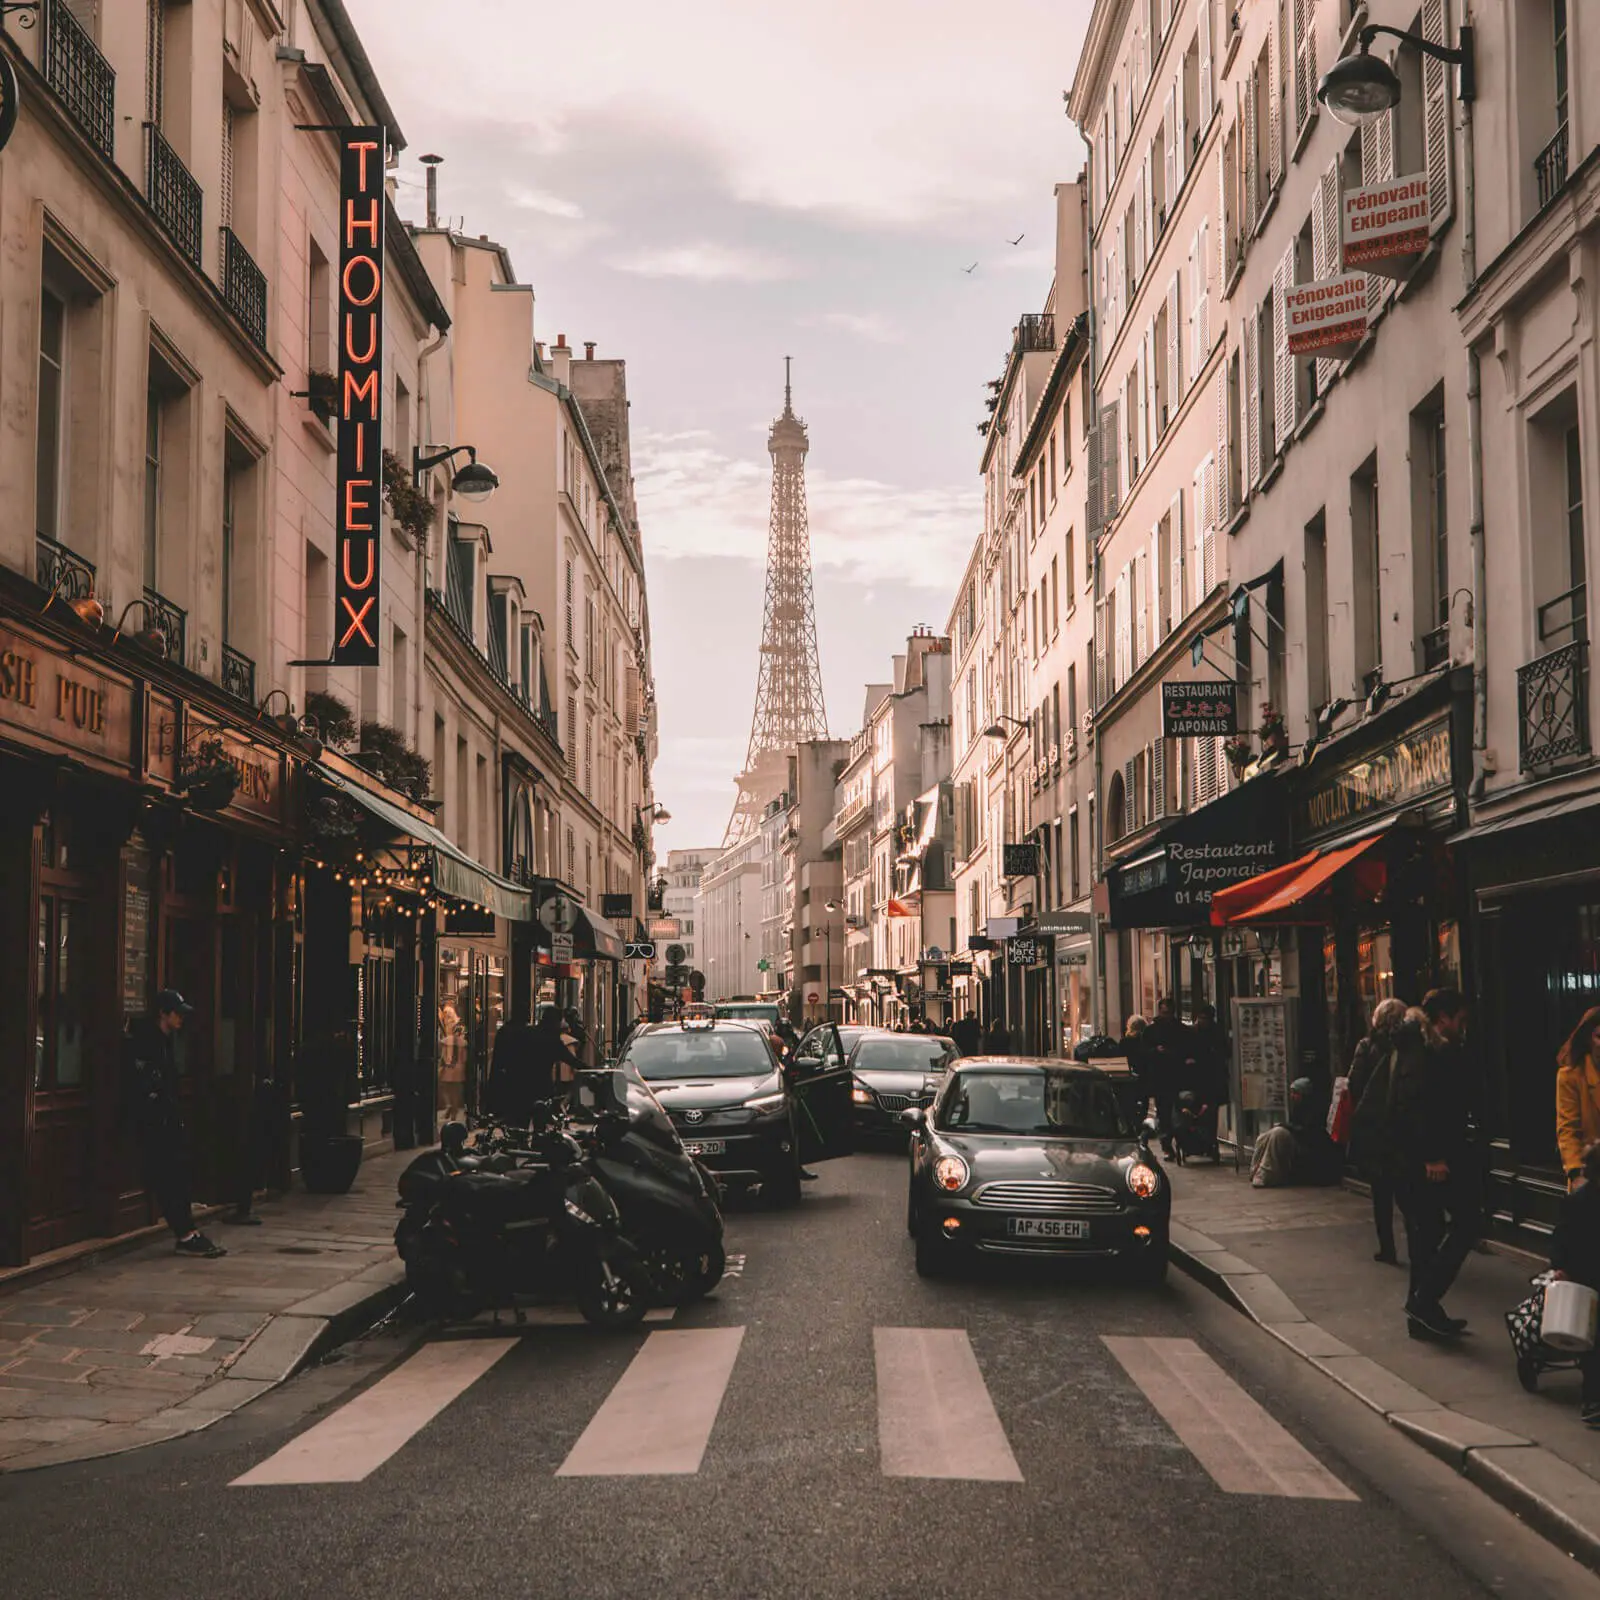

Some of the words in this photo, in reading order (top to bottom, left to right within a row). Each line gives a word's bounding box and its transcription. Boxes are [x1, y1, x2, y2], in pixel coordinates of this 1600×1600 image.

[1351, 200, 1428, 232] Exigeant
[338, 142, 380, 647] THOUMIEUX
[0, 651, 35, 709] SH
[1164, 684, 1232, 697] RESTAURANT
[1172, 720, 1228, 733] JAPONAIS
[1309, 779, 1350, 827] MOULIN
[1397, 730, 1451, 792] VIERGE
[1168, 841, 1275, 860] Restaurant
[1180, 861, 1266, 884] Japonais
[1175, 891, 1190, 904] 01
[1195, 890, 1212, 903] 45
[1009, 947, 1035, 957] Marc
[1013, 939, 1035, 949] Karl
[1009, 954, 1035, 964] John
